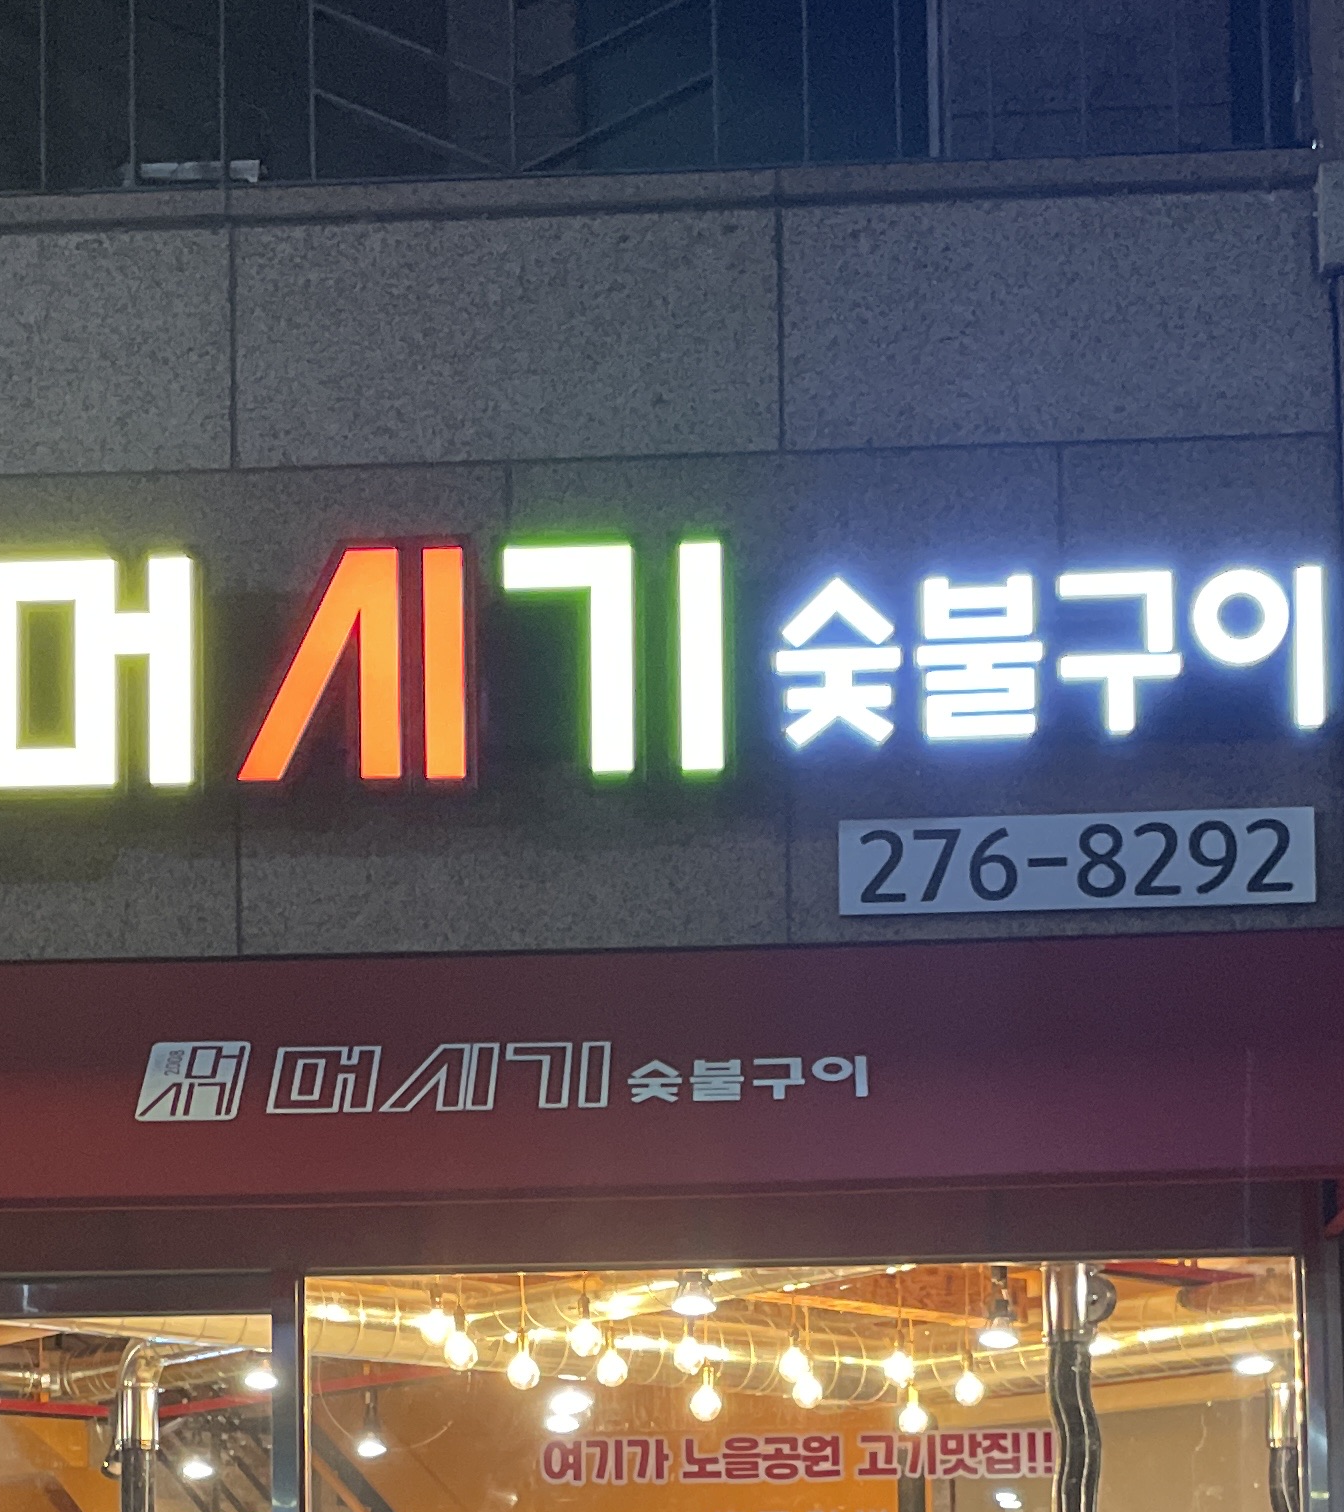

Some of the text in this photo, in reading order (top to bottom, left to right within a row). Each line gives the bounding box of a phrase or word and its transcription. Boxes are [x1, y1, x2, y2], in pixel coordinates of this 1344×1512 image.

[775, 563, 1327, 749] 숯불구이
[859, 819, 1293, 903] 276-8292
[266, 1042, 868, 1113] 머세기 숯불구이
[542, 1436, 671, 1486] 여기가
[855, 1428, 1057, 1479] 고기맛집!!
